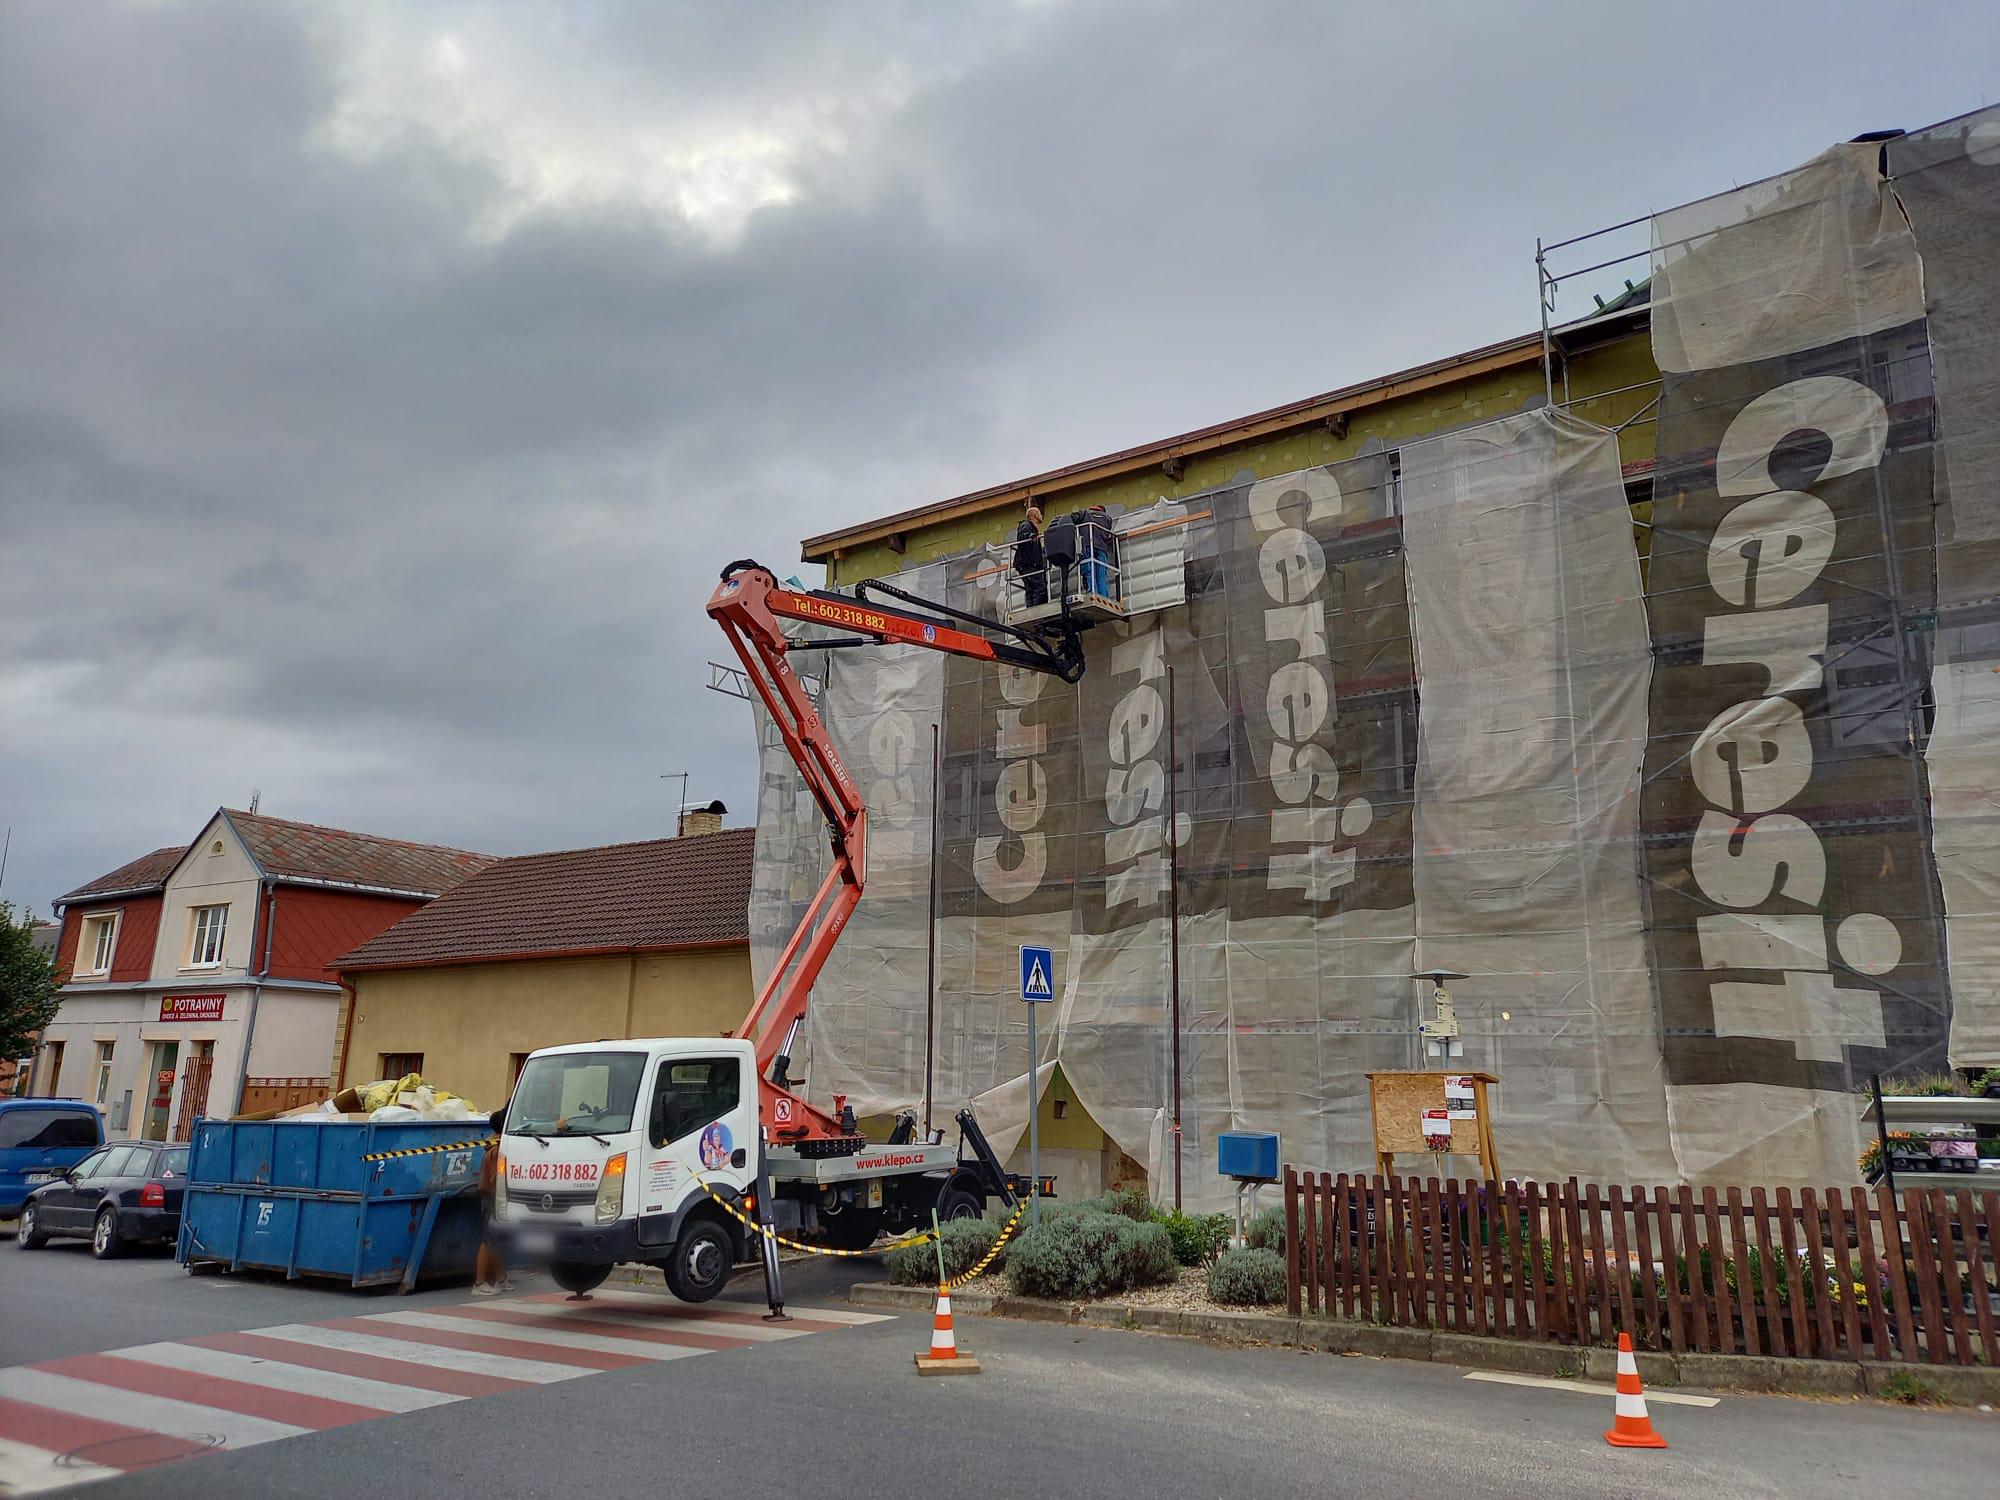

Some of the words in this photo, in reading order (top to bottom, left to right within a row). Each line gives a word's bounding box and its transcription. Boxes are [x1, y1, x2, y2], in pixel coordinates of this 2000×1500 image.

[793, 598, 818, 615] Tel.:
[819, 604, 841, 621] 602
[843, 609, 863, 624] 318
[865, 614, 885, 630] 882
[1248, 463, 1374, 901] Ceresit
[1691, 374, 1903, 1064] Ceresit
[823, 743, 850, 788] socage
[173, 998, 222, 1012] POTRAVINY
[378, 1160, 387, 1172] 2
[510, 1164, 528, 1180] Tel.:
[529, 1163, 549, 1180] 602
[551, 1163, 571, 1180] 318
[574, 1163, 598, 1181] 882
[856, 1154, 924, 1170] www.klepo.cz
